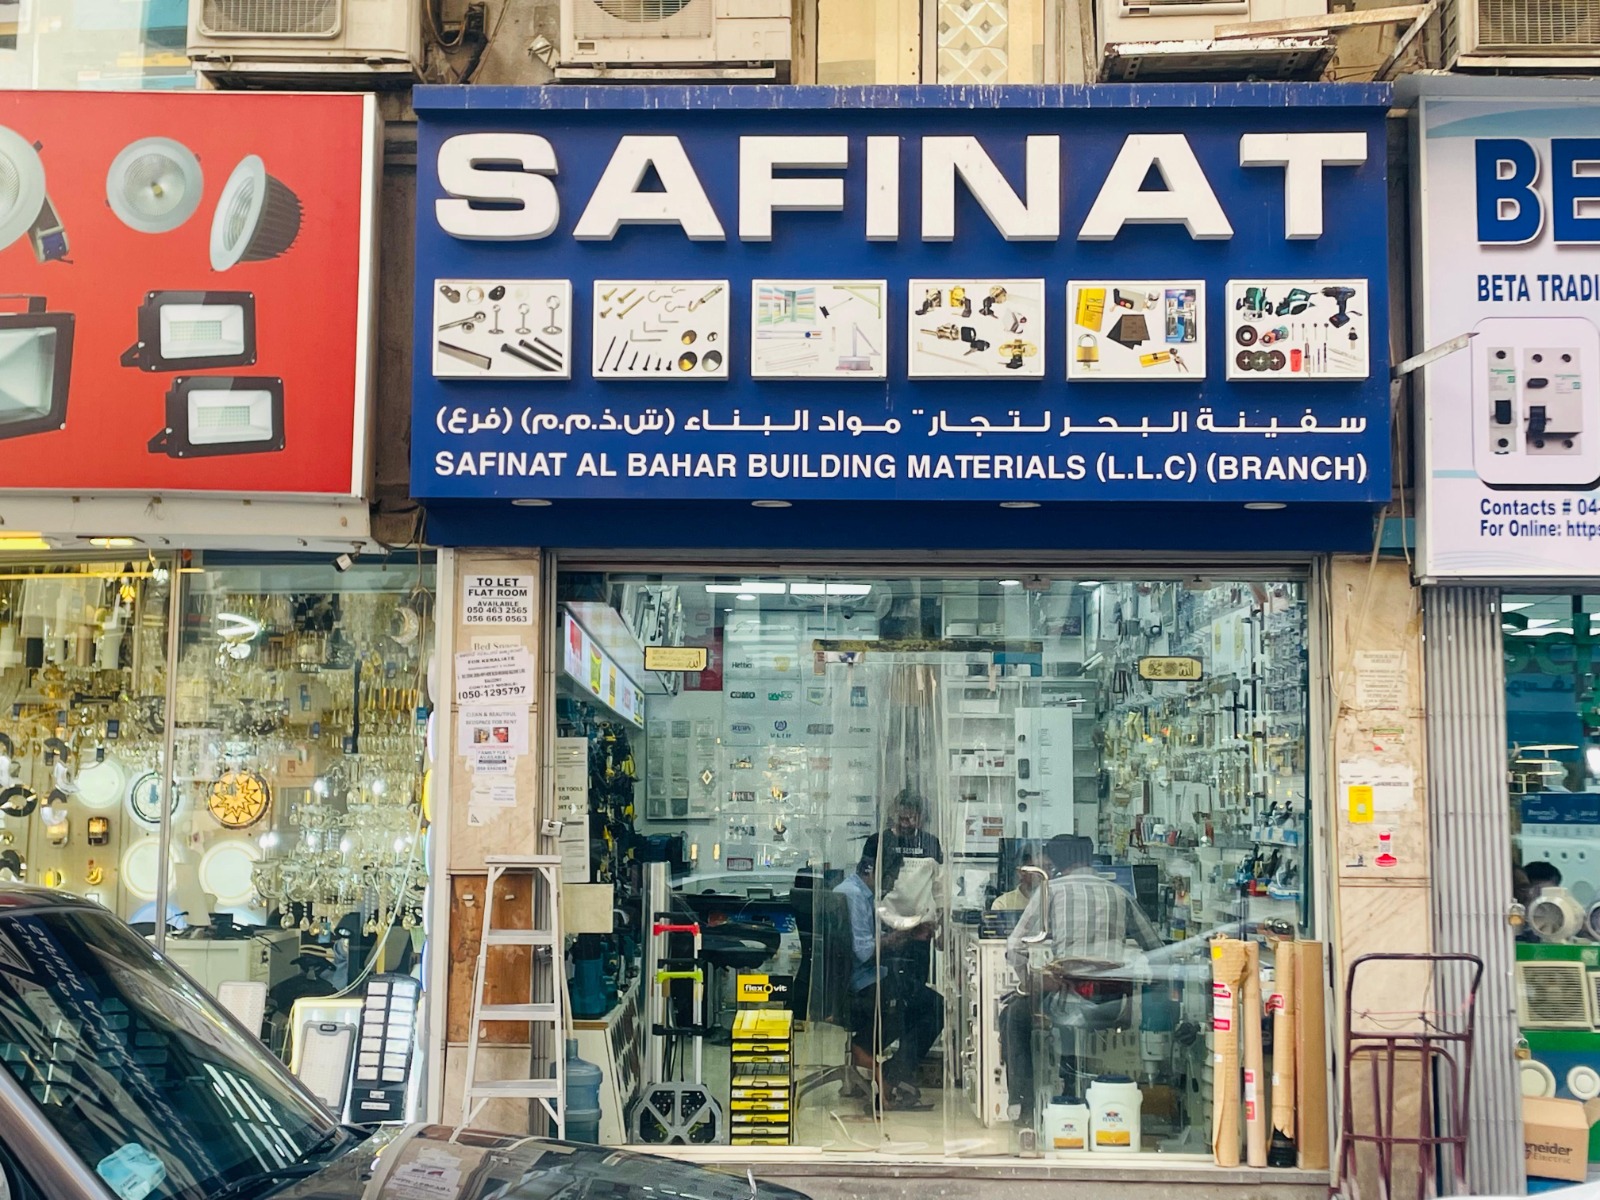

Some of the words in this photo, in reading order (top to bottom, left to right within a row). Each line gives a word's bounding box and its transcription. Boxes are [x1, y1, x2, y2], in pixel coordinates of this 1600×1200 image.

[435, 131, 1368, 242] SAFINAT
[1478, 274, 1530, 302] BETA
[436, 405, 513, 435] (فرع)
[683, 408, 810, 436] البناء
[818, 408, 902, 437] مواد
[912, 408, 1051, 437] لتجار
[1059, 409, 1189, 438] البحر
[1197, 407, 1367, 438] سفينة
[434, 451, 568, 477] SAFINAT
[575, 452, 618, 477] AL
[627, 452, 738, 478] BAHAR
[748, 453, 897, 479] BUILDING
[907, 454, 1086, 480] MATERIALS
[1096, 452, 1198, 483] (L.L.C)
[1206, 452, 1367, 484] (BRANCH)
[1480, 498, 1556, 515] Contacts
[1562, 499, 1572, 515] #
[1480, 519, 1504, 537] For
[1509, 519, 1562, 537] Online:
[468, 588, 494, 597] FLAT
[497, 589, 528, 597] ROOM
[477, 577, 493, 587] TO
[497, 577, 519, 587] LET
[467, 606, 484, 614] 050
[486, 606, 503, 614] 463
